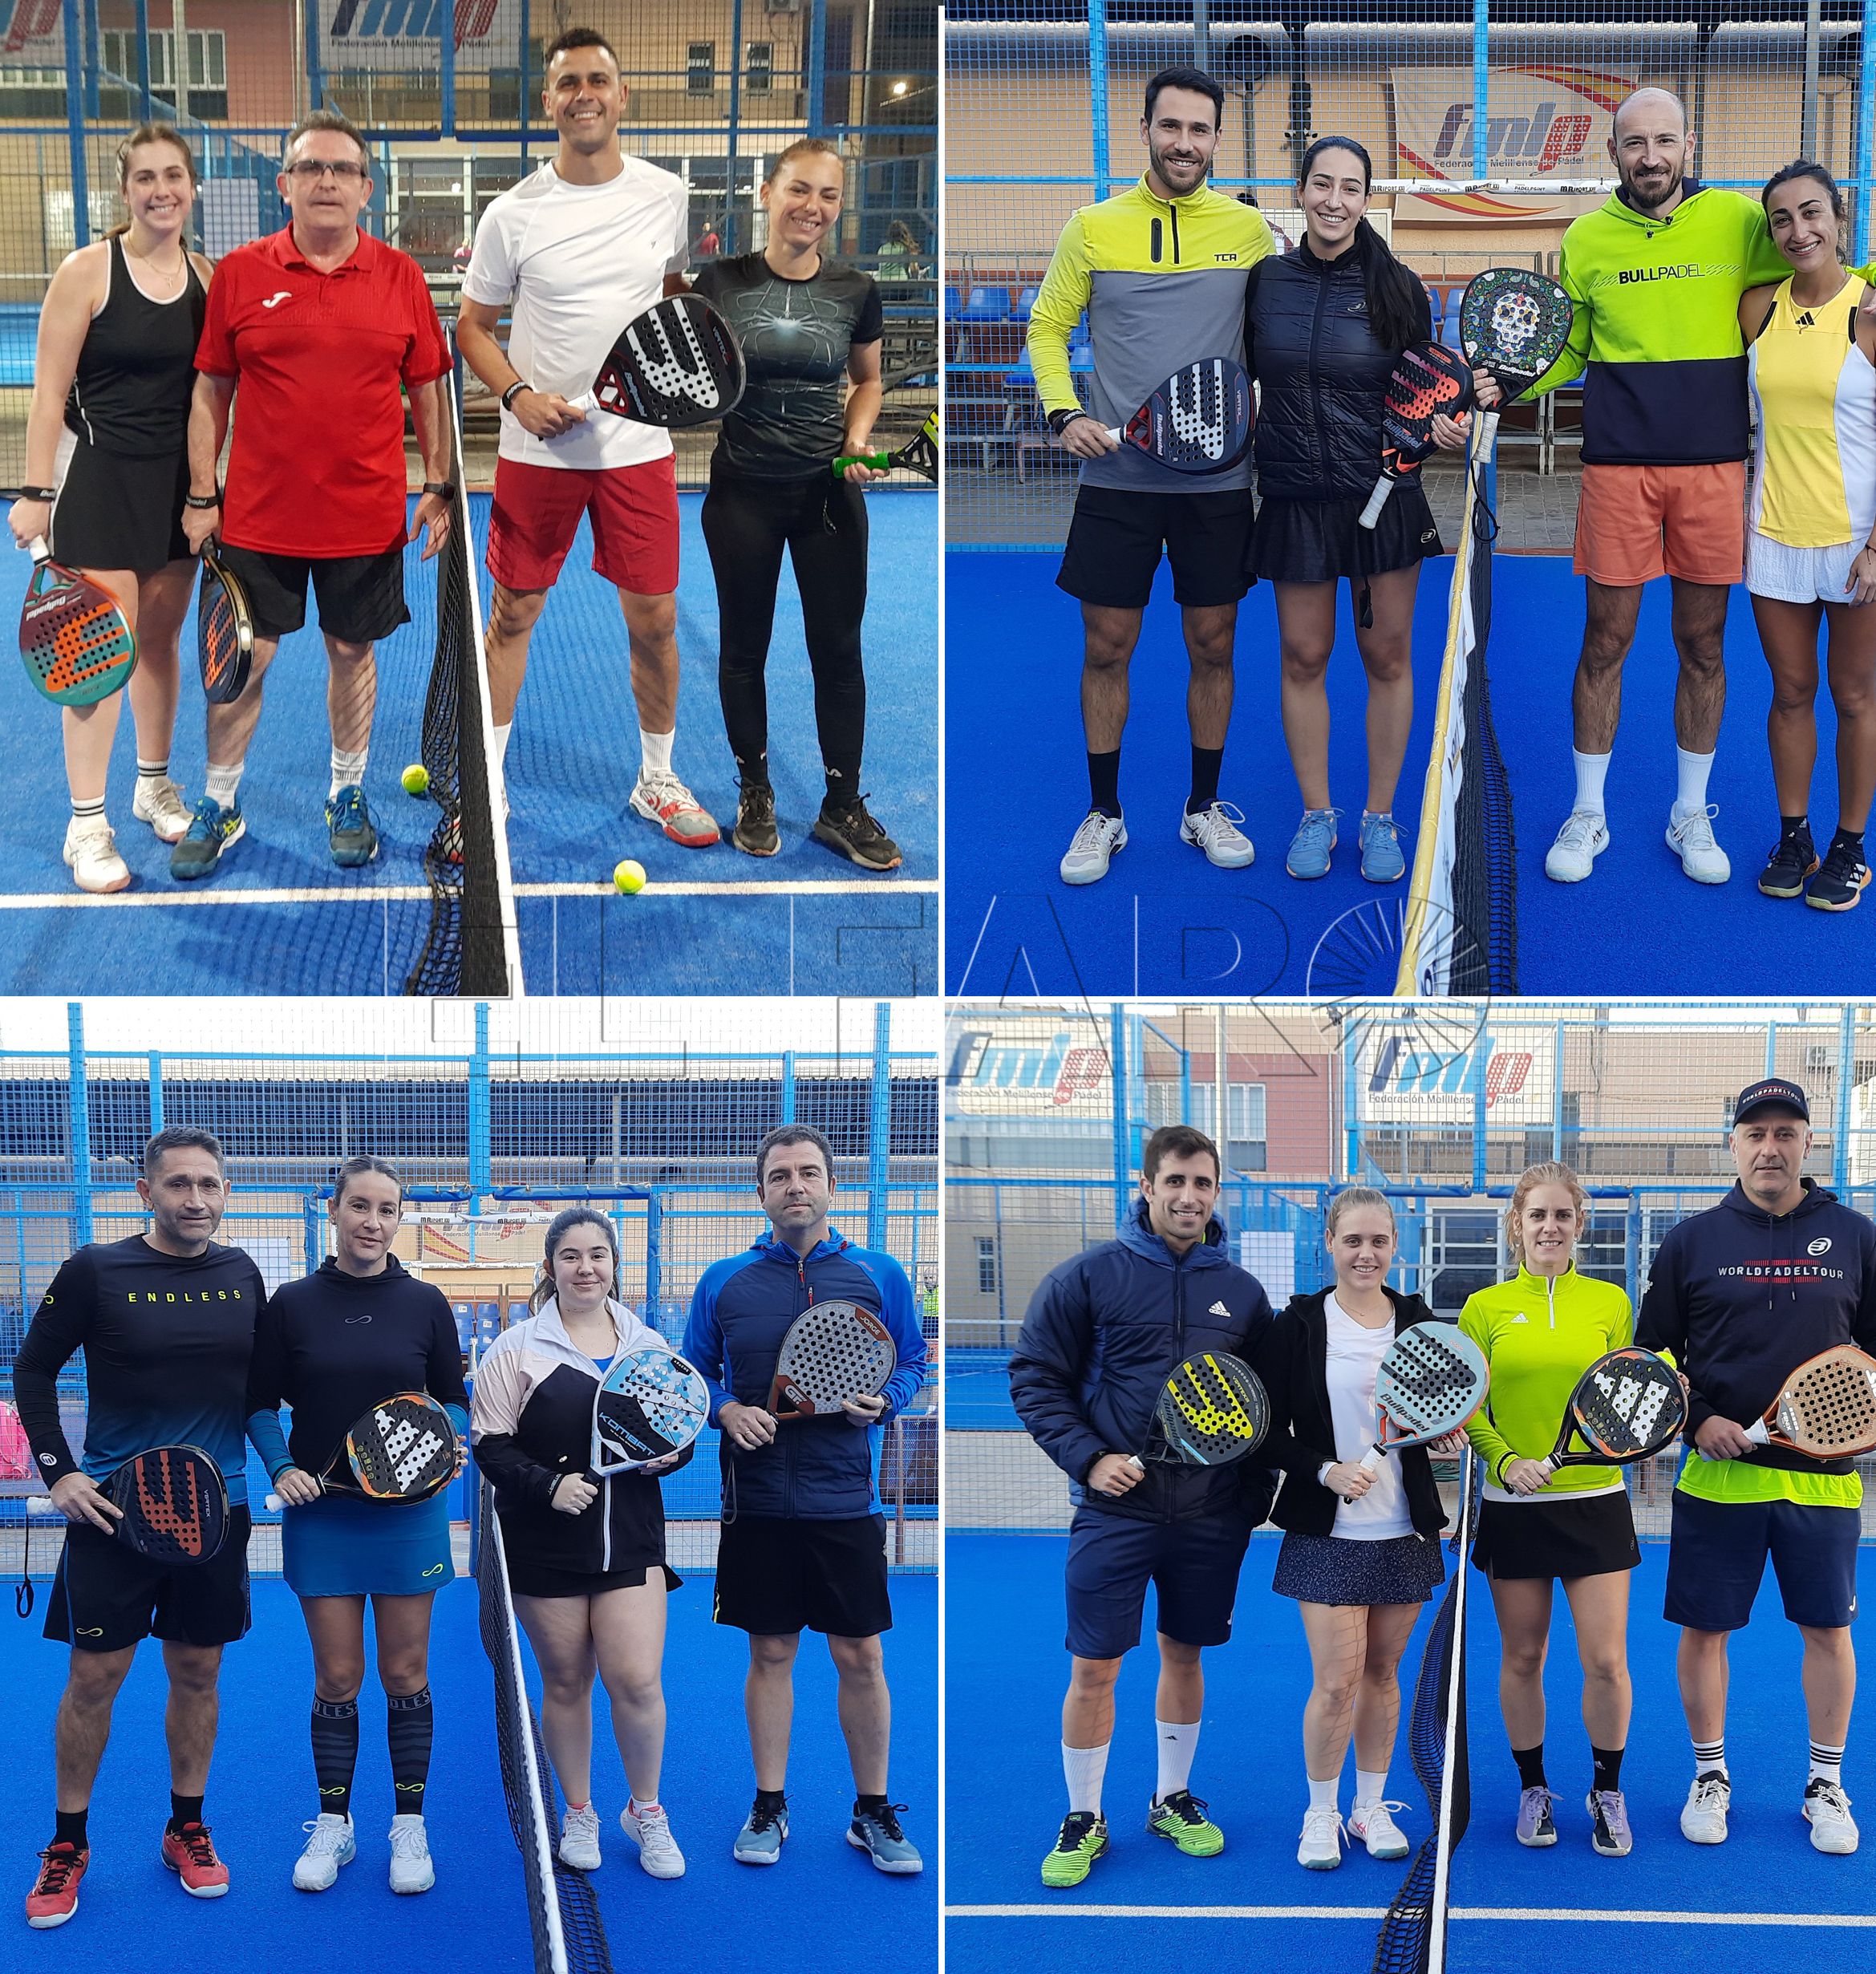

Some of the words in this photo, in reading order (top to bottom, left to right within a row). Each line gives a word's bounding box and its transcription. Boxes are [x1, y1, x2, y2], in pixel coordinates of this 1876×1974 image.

[331, 39, 388, 48] Federación
[1558, 156, 1585, 165] Pádel
[1214, 253, 1237, 261] TCA
[1619, 263, 1705, 285] BULLPADEL
[1497, 363, 1537, 378] Bullpadel
[1157, 412, 1165, 457] Bullpadel
[1382, 418, 1424, 449] Bullpadel
[26, 595, 67, 621] Bullpadel
[1368, 1093, 1424, 1104] Federación
[1497, 1094, 1525, 1104] Pádel
[128, 1289, 241, 1303] ENDLESS
[860, 1315, 881, 1336] JORGE
[1163, 1398, 1182, 1449] Bullpadel
[1380, 1393, 1430, 1433] Bullpadel
[598, 1412, 656, 1456] KOMBAT
[204, 1490, 212, 1518] VERTEX
